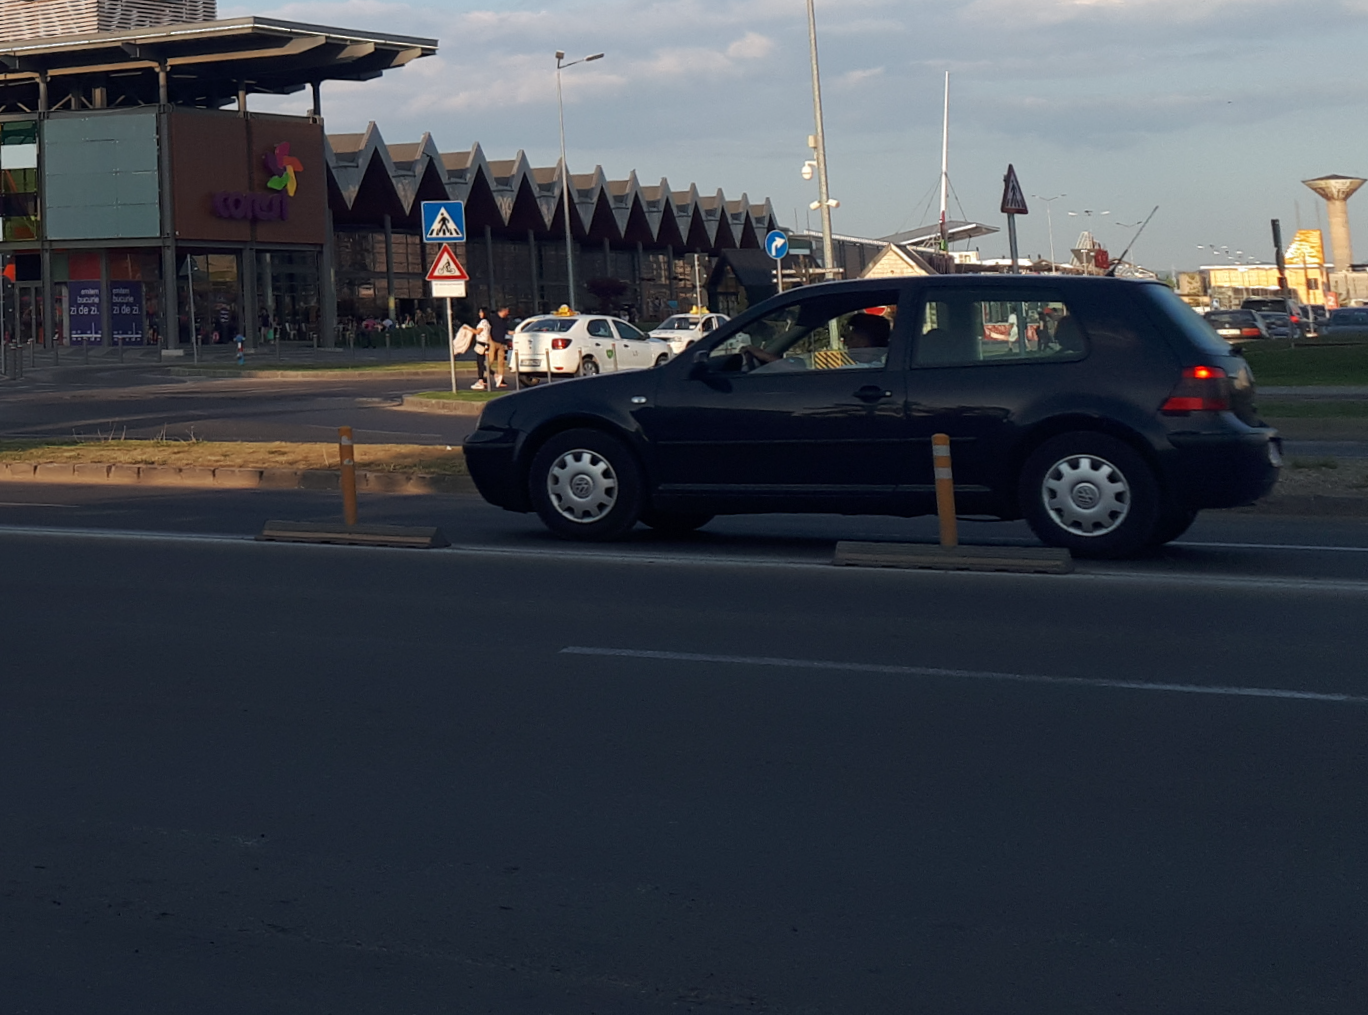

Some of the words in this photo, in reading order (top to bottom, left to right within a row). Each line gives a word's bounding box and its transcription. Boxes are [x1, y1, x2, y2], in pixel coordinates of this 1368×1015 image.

[70, 305, 76, 315] zi
[78, 305, 89, 315] de
[121, 304, 131, 314] de
